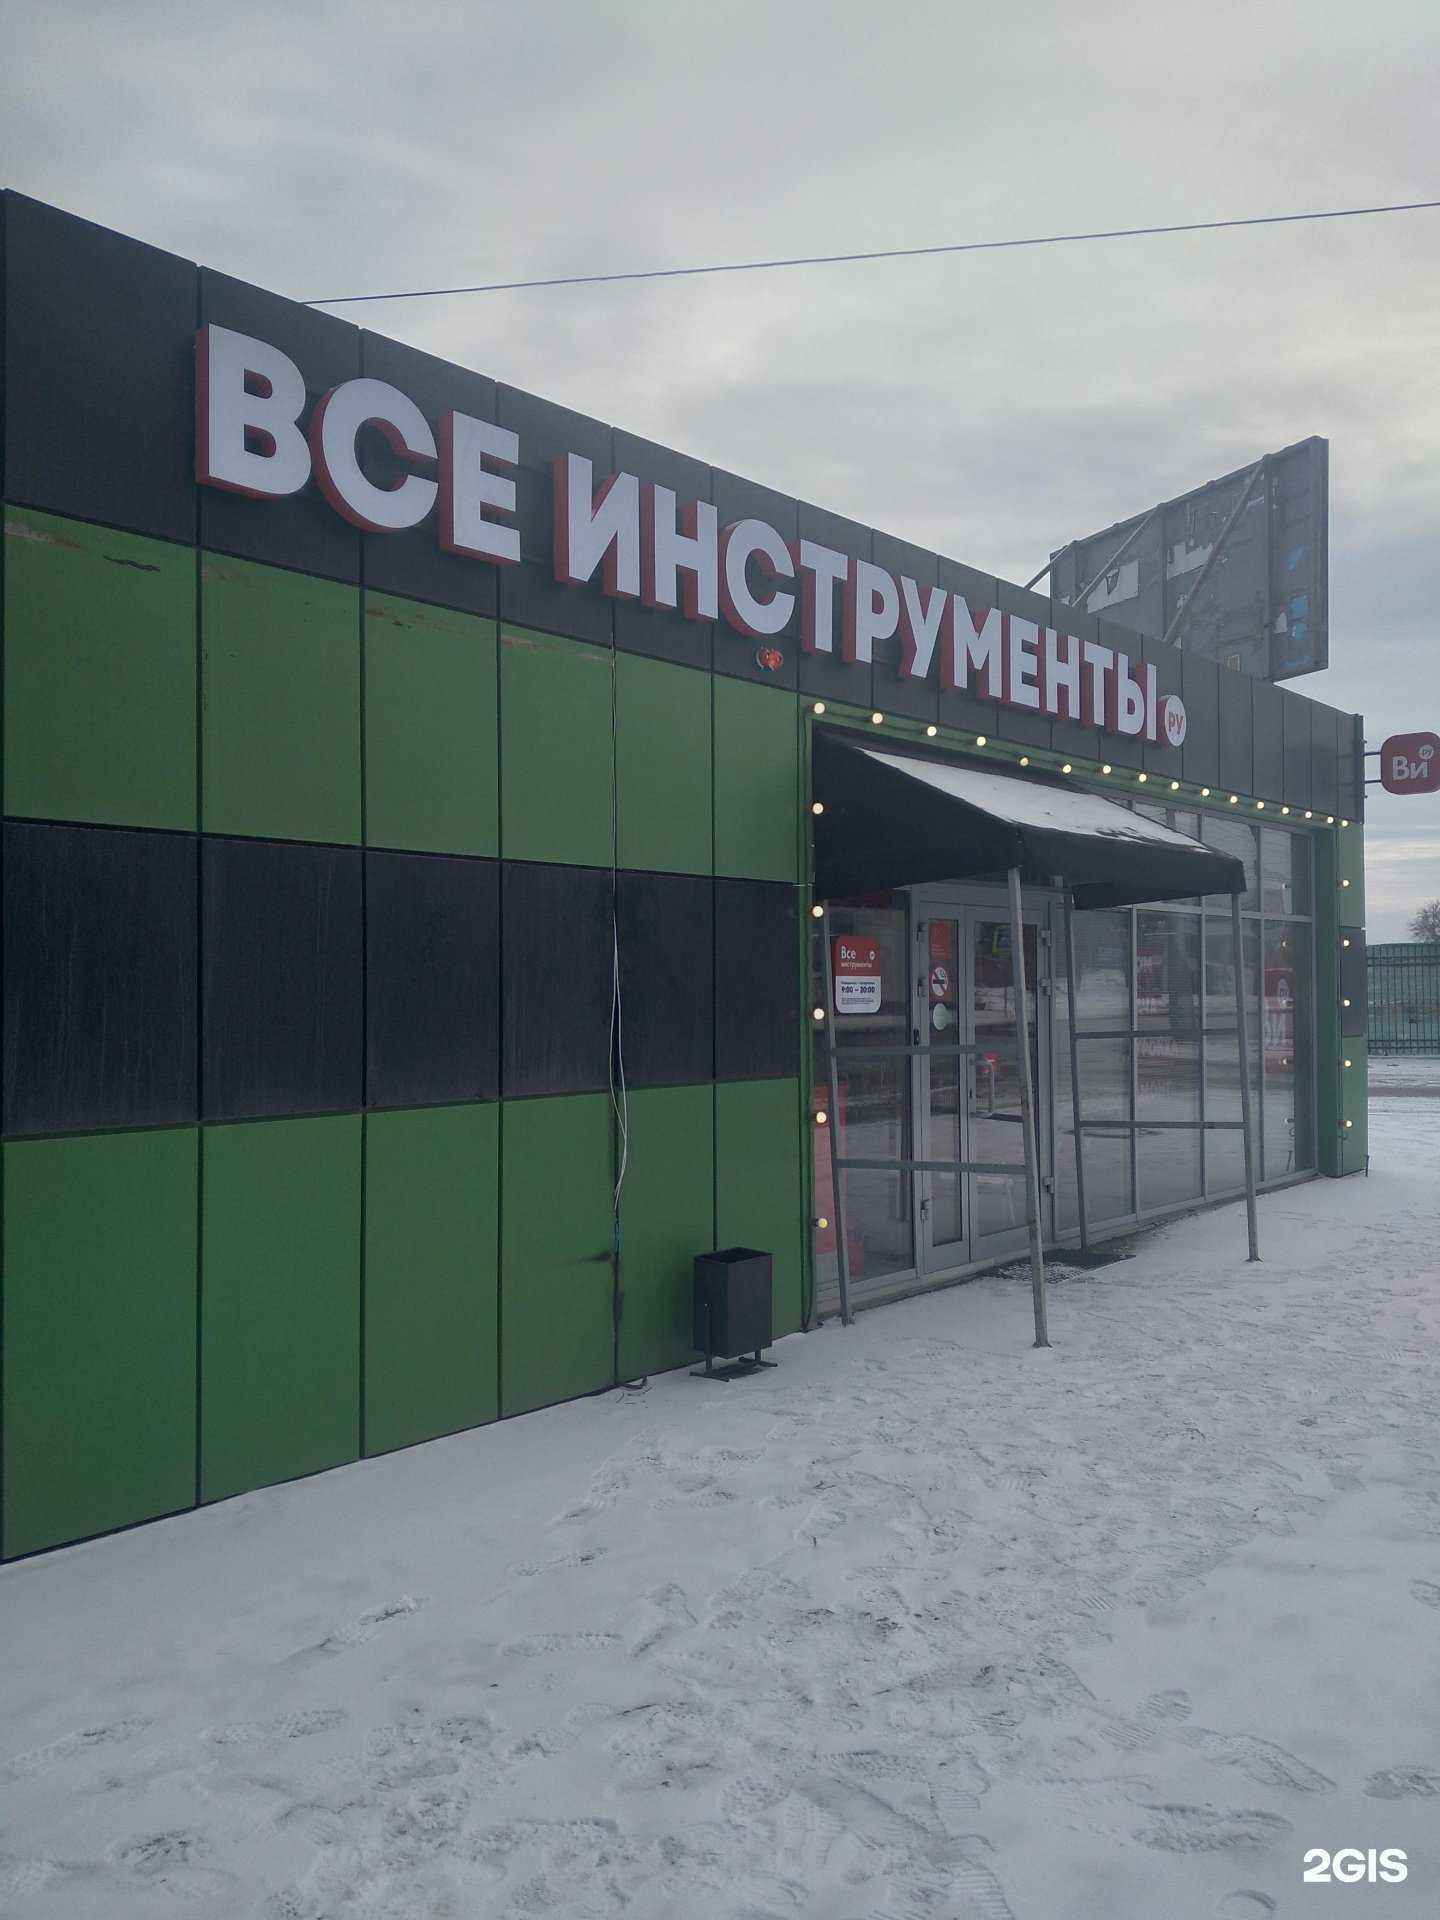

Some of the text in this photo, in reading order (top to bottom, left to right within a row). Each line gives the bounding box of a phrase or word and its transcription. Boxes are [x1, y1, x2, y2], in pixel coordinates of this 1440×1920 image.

[203, 323, 1157, 741] ВСЕ ИНСТРУМЕНТЫ
[841, 946, 857, 960] Все
